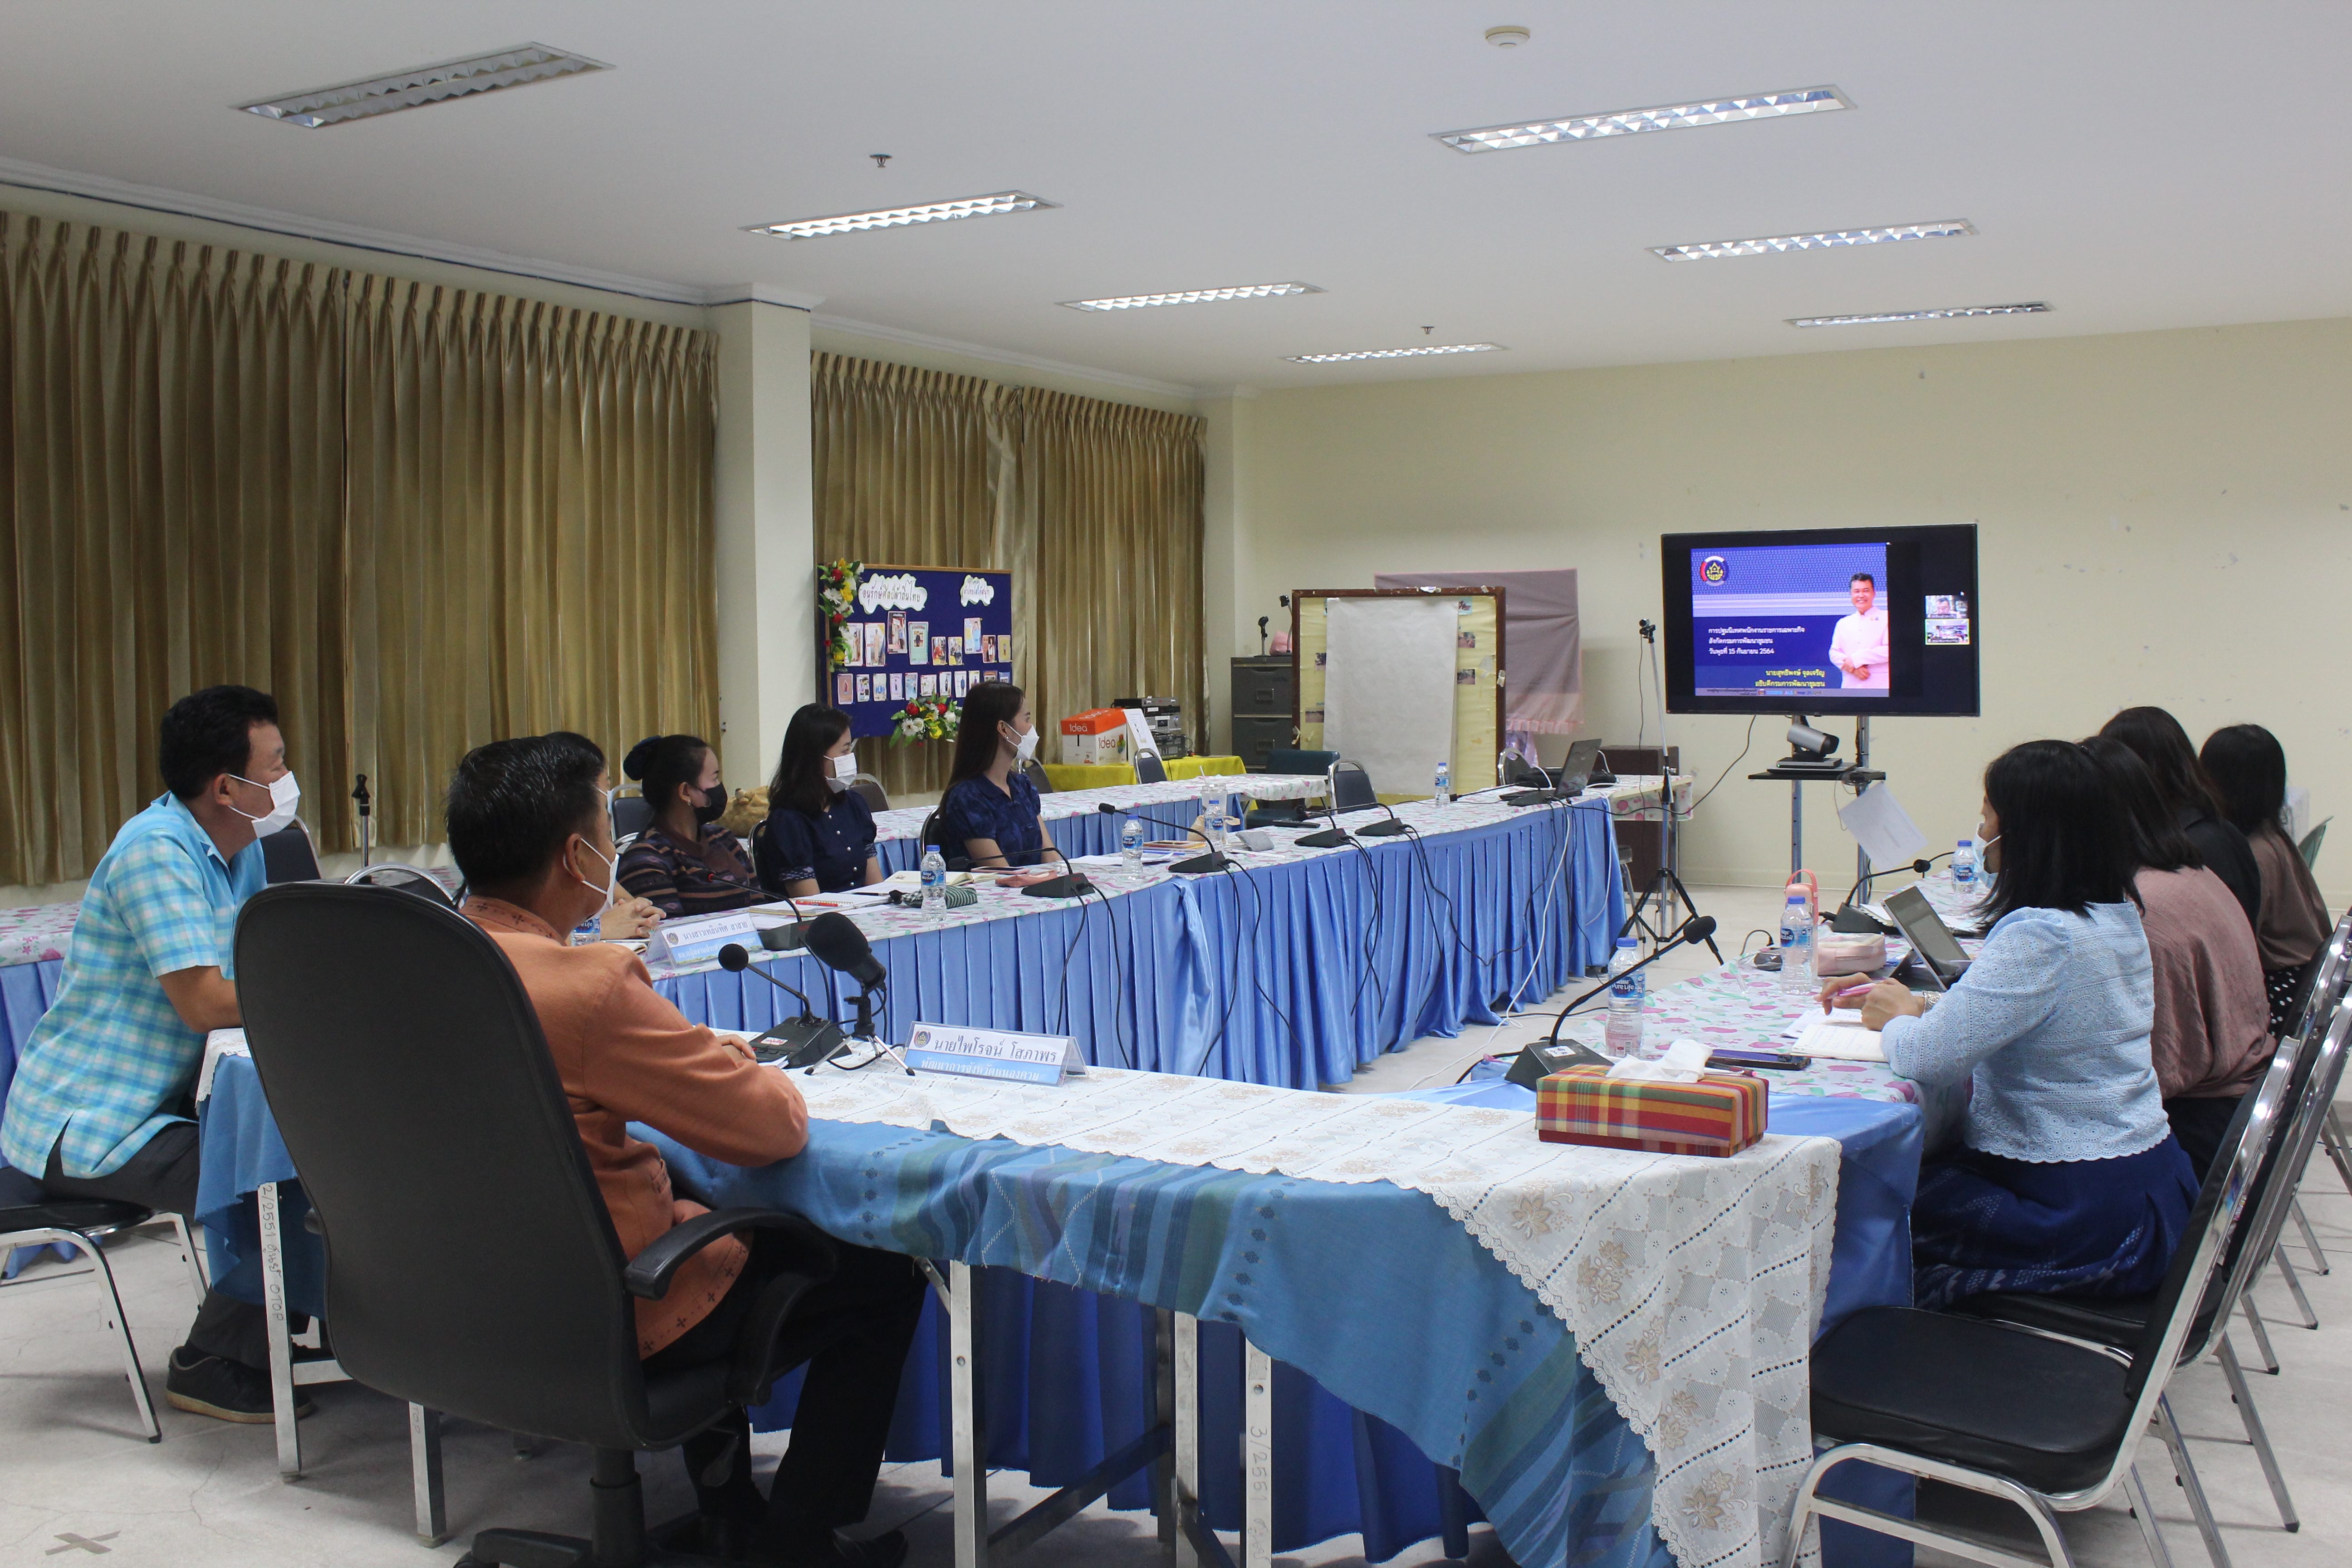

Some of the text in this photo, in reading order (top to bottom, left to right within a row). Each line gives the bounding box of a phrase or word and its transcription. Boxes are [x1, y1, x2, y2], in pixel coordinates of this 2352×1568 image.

[1708, 637, 1774, 646] สังกัดกรมการพัฒนาชุมชน
[1765, 668, 1825, 678] นายสุทธิพงษ์ จุลเจริญ
[1755, 680, 1825, 689] อธิบดีกรมการพัฒนาชุมชน
[1069, 724, 1088, 732] idea
[1098, 736, 1116, 749] idea
[1624, 984, 1634, 992] Life
[934, 1034, 1058, 1063] นายไพโรจน์ โสภาพร
[921, 1057, 1040, 1081] พัฒนาการจังหวัดหนองคาย
[261, 1185, 276, 1237] 2/2551
[270, 1284, 284, 1321] OTOP
